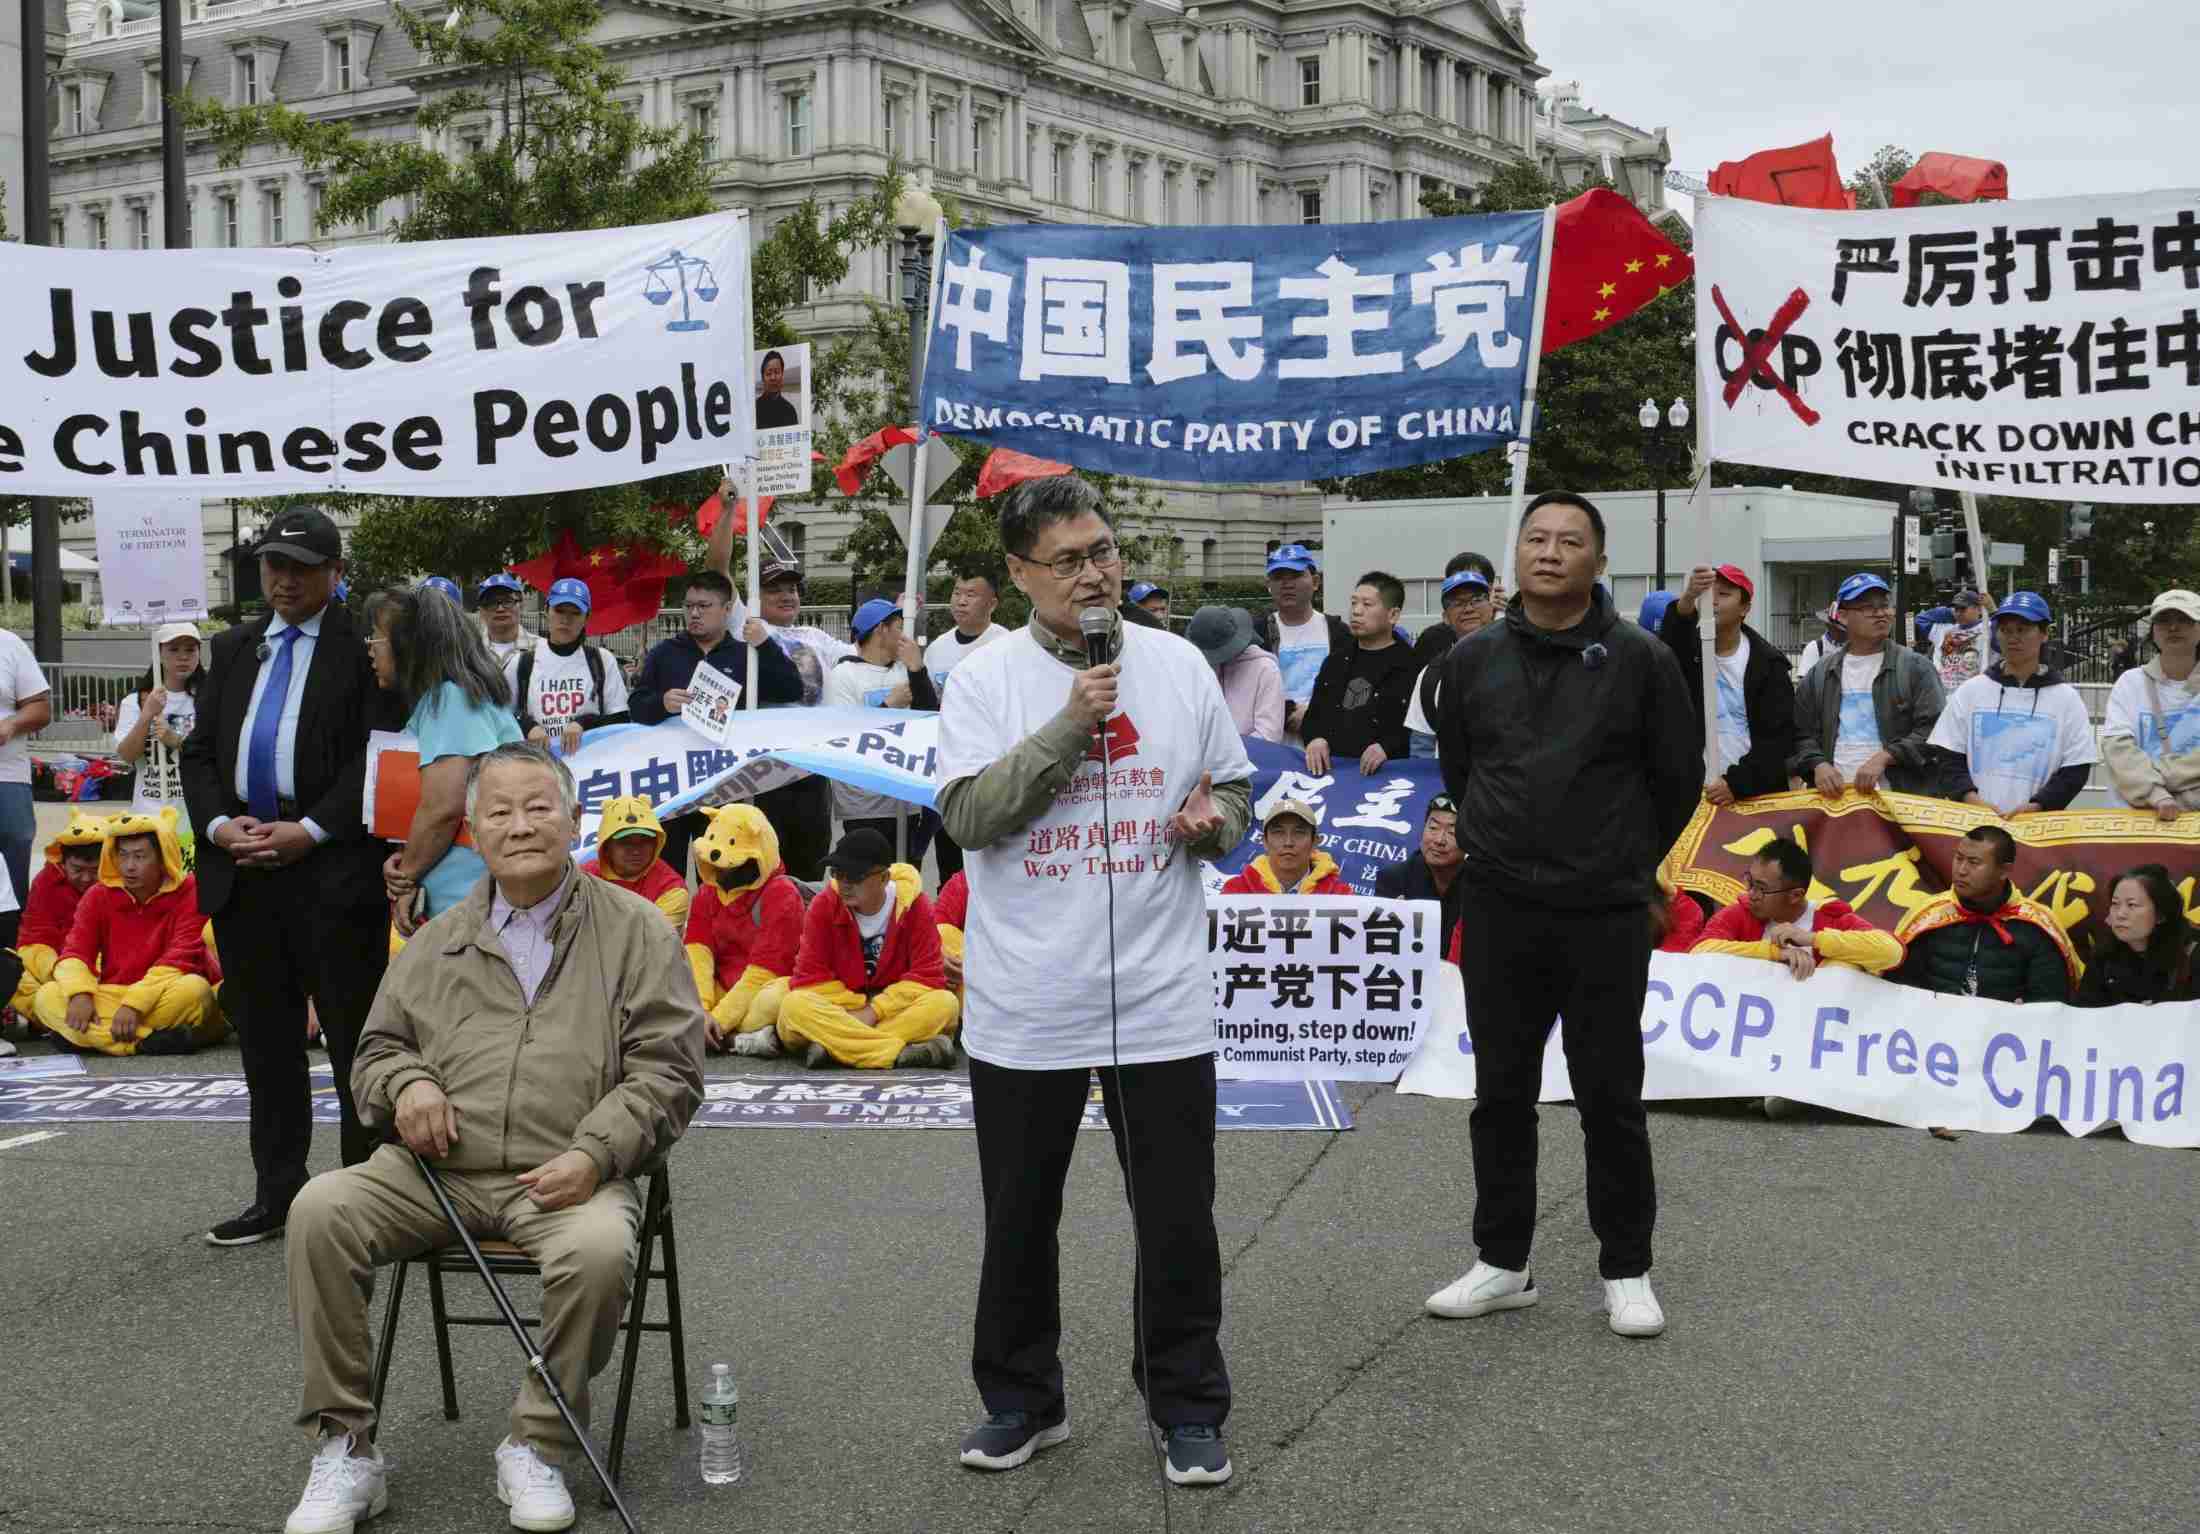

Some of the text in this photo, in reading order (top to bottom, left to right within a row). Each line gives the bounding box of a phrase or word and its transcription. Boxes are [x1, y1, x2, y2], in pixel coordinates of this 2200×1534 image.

[1831, 210, 2200, 307] 严厉打击中
[24, 267, 605, 378] Justice for
[938, 243, 1530, 386] 中国民主党
[1714, 322, 1823, 392] CCP
[1835, 309, 2200, 401] 彻底堵住中
[54, 407, 443, 477] Chinese
[474, 362, 731, 465] People
[935, 397, 1515, 453] DEMOCRATIC PARTY OF CHINA
[1847, 420, 1986, 453] CRACK
[1999, 416, 2134, 453] DOWN
[119, 527, 187, 539] TERMINATOR
[120, 539, 186, 551] OF FREEDOM
[541, 678, 584, 692] I HATE
[541, 692, 585, 716] CCP
[856, 732, 937, 777] Park
[1120, 790, 1134, 800] OF
[1024, 859, 1072, 882] Way
[1082, 854, 1145, 876] Truth
[1343, 838, 1408, 863] CHINA
[1206, 906, 1425, 955] 近平下台!
[1212, 963, 1424, 1012] 产党下台!
[1299, 1019, 1348, 1044] step
[1352, 1018, 1416, 1042] down!
[1223, 1047, 1305, 1063] Communist
[1309, 1048, 1351, 1067] Party,
[1355, 1052, 1386, 1067] step
[1810, 1006, 1960, 1087] Free
[1982, 1032, 2185, 1124] China
